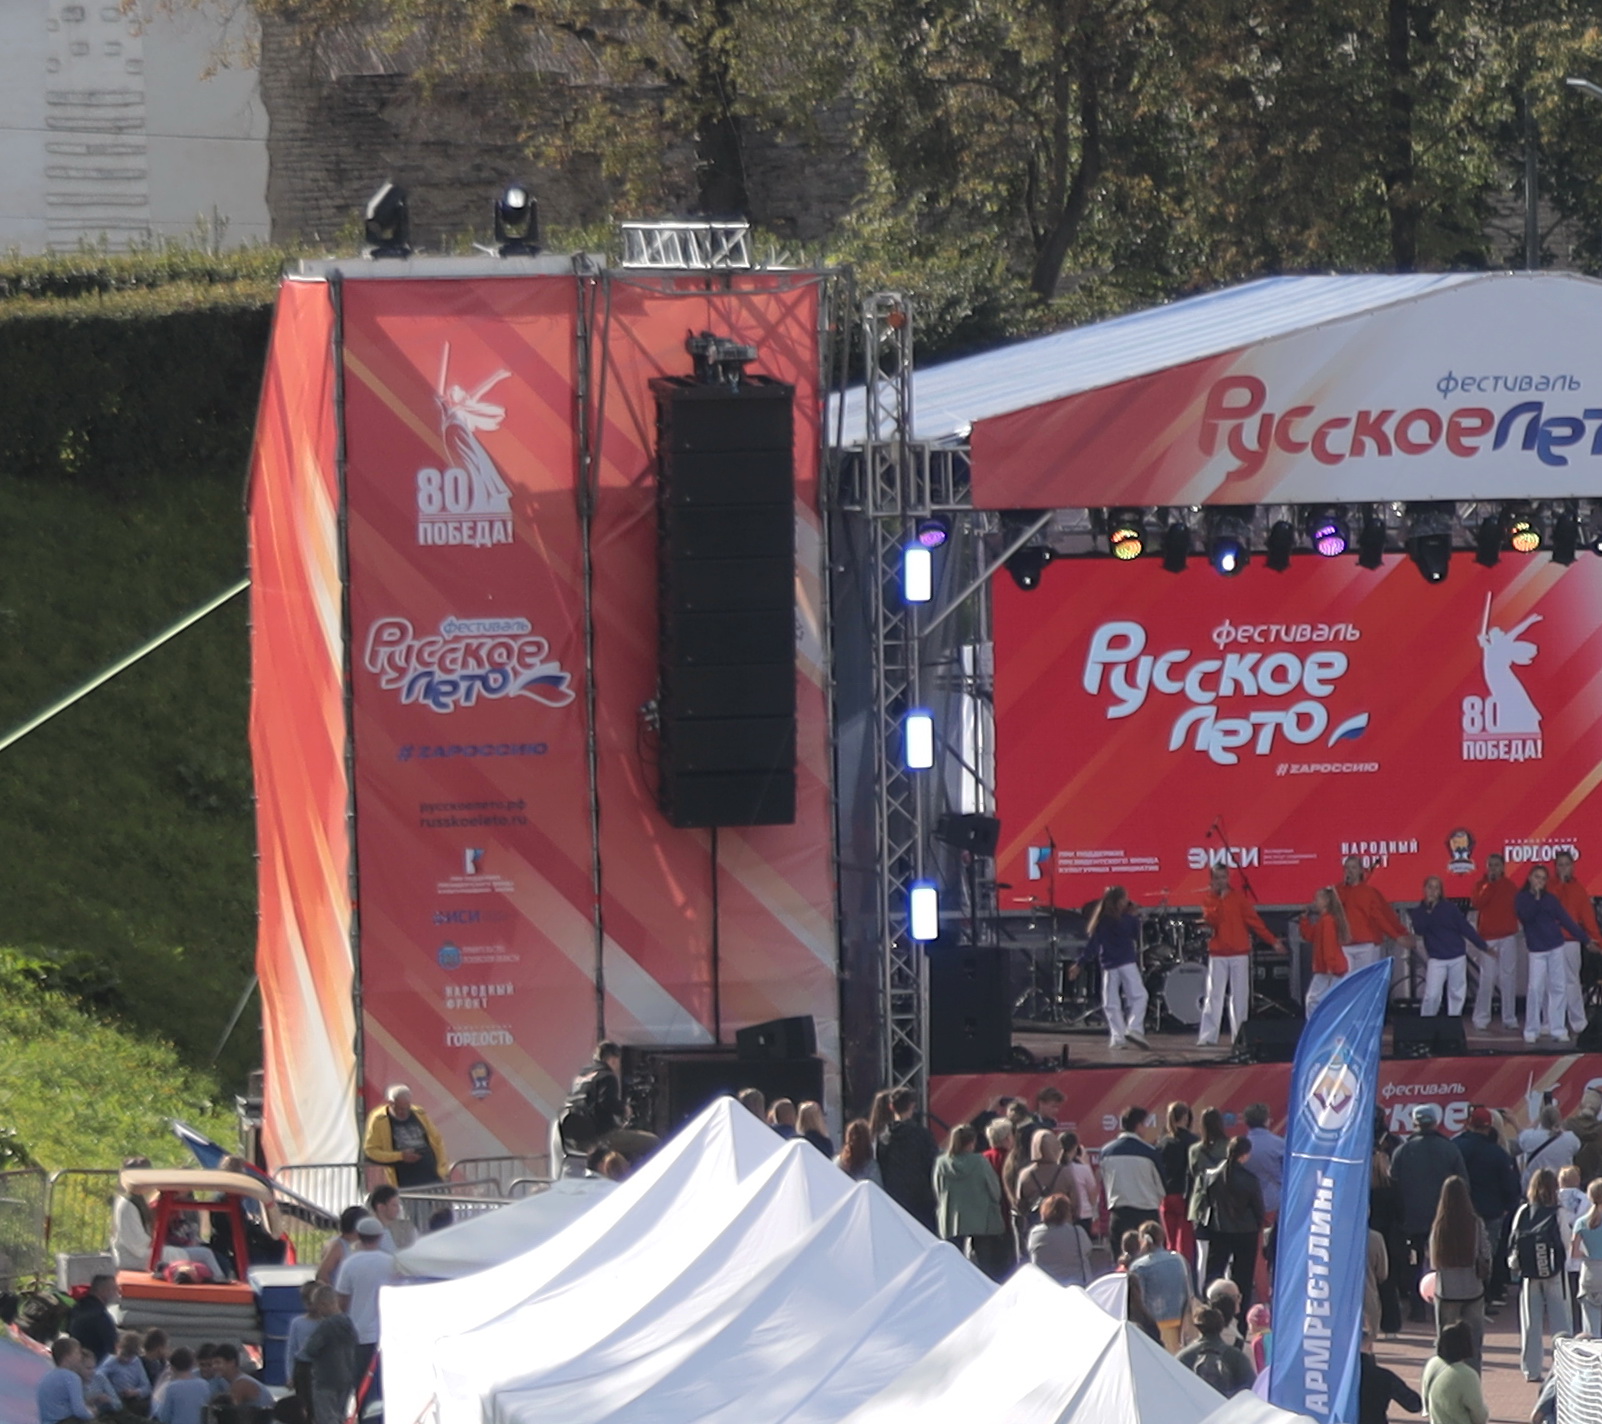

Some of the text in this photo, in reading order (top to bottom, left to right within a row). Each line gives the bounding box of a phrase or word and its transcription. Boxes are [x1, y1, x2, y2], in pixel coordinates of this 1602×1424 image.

[1437, 370, 1580, 399] фестиваль
[1199, 374, 1495, 481] Русское
[416, 468, 468, 515] 80
[418, 520, 513, 547] ПОБЕДА!
[441, 617, 531, 640] фестиваль
[1212, 619, 1361, 650] фестиваль
[365, 618, 549, 689] Русское
[1083, 620, 1348, 719] Русское
[401, 668, 514, 714] Лето
[1168, 701, 1328, 765] Лето
[1461, 696, 1499, 735] 80
[1461, 739, 1543, 763] ПОБЕДА!
[1341, 838, 1418, 855] НАРОДНЫЙ
[1382, 1082, 1466, 1099] фестиваль
[1303, 1169, 1335, 1415] АРМРЕСТЛИНГ
